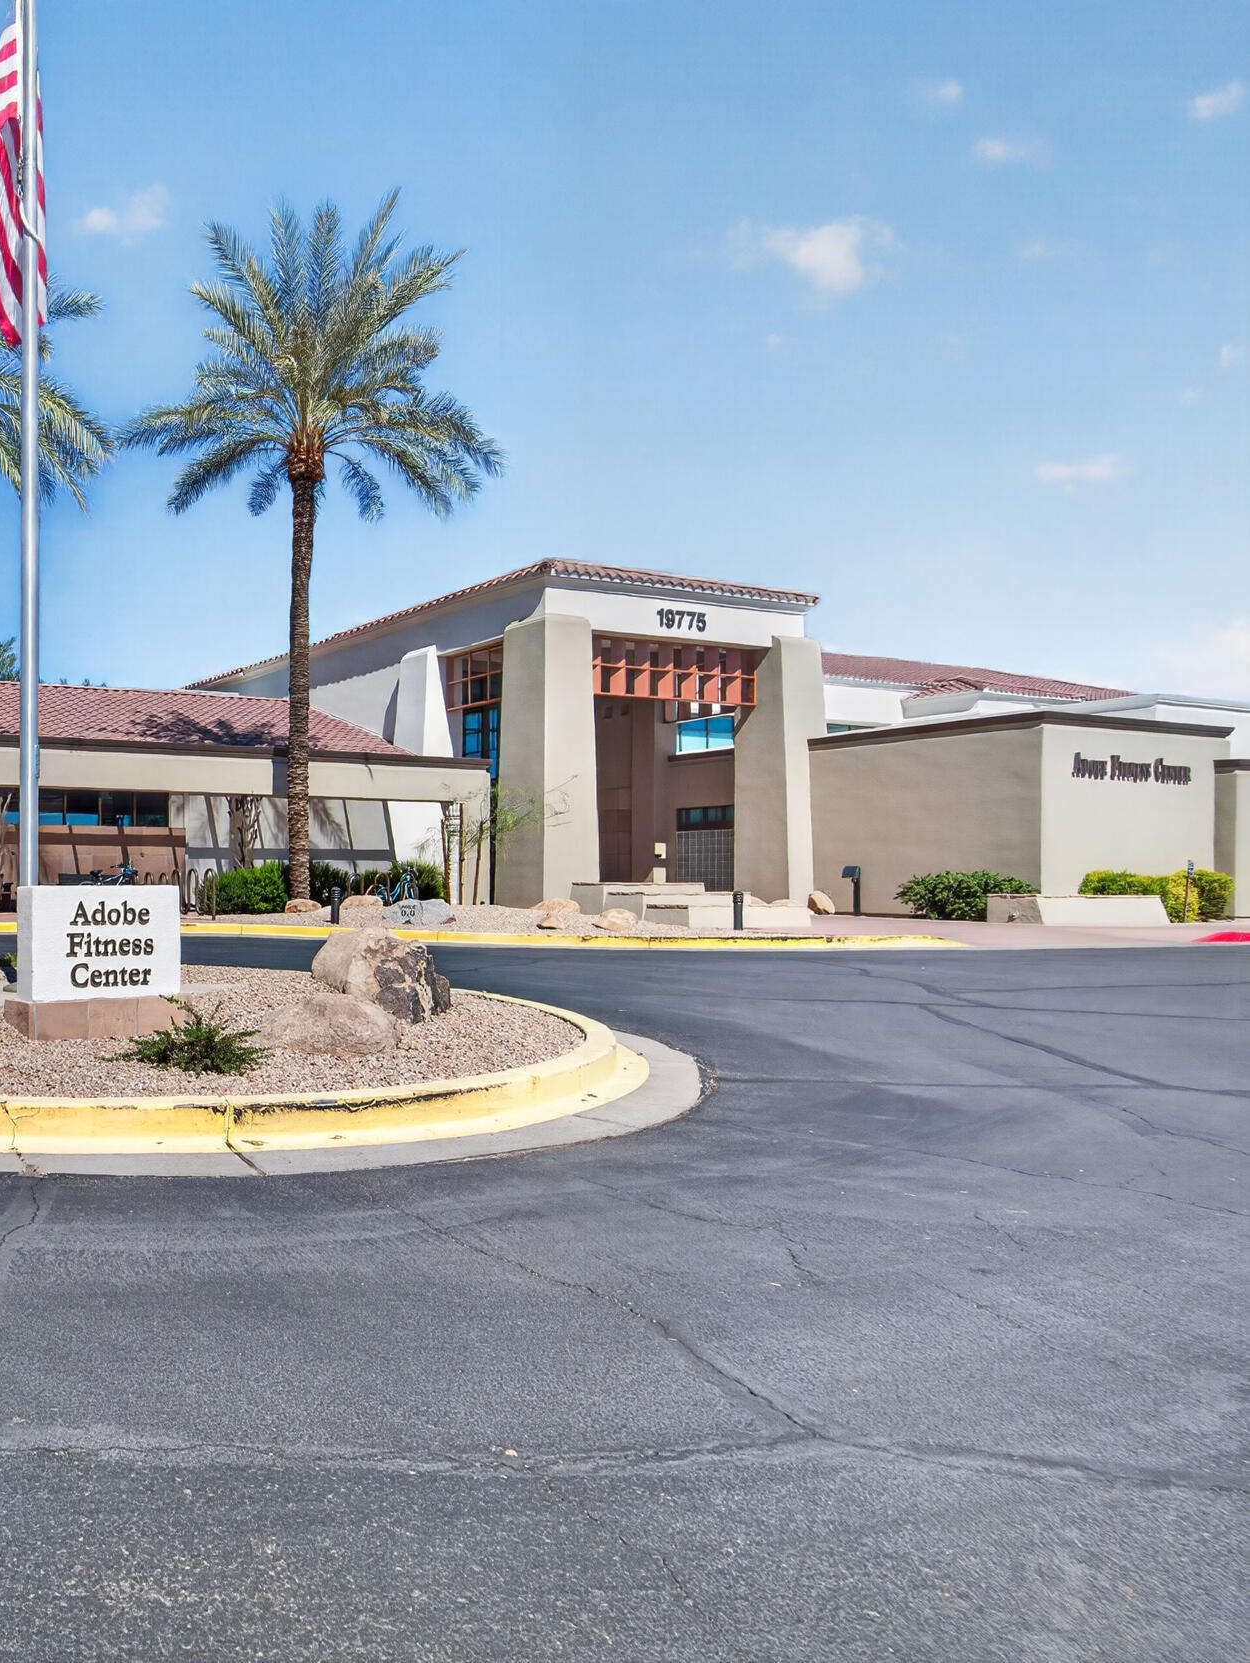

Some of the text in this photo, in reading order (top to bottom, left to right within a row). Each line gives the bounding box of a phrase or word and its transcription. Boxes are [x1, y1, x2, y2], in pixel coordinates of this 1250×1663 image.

[656, 607, 707, 633] 19775
[69, 900, 150, 926] Adobe
[66, 932, 154, 958] Fitness
[70, 962, 151, 989] Center
